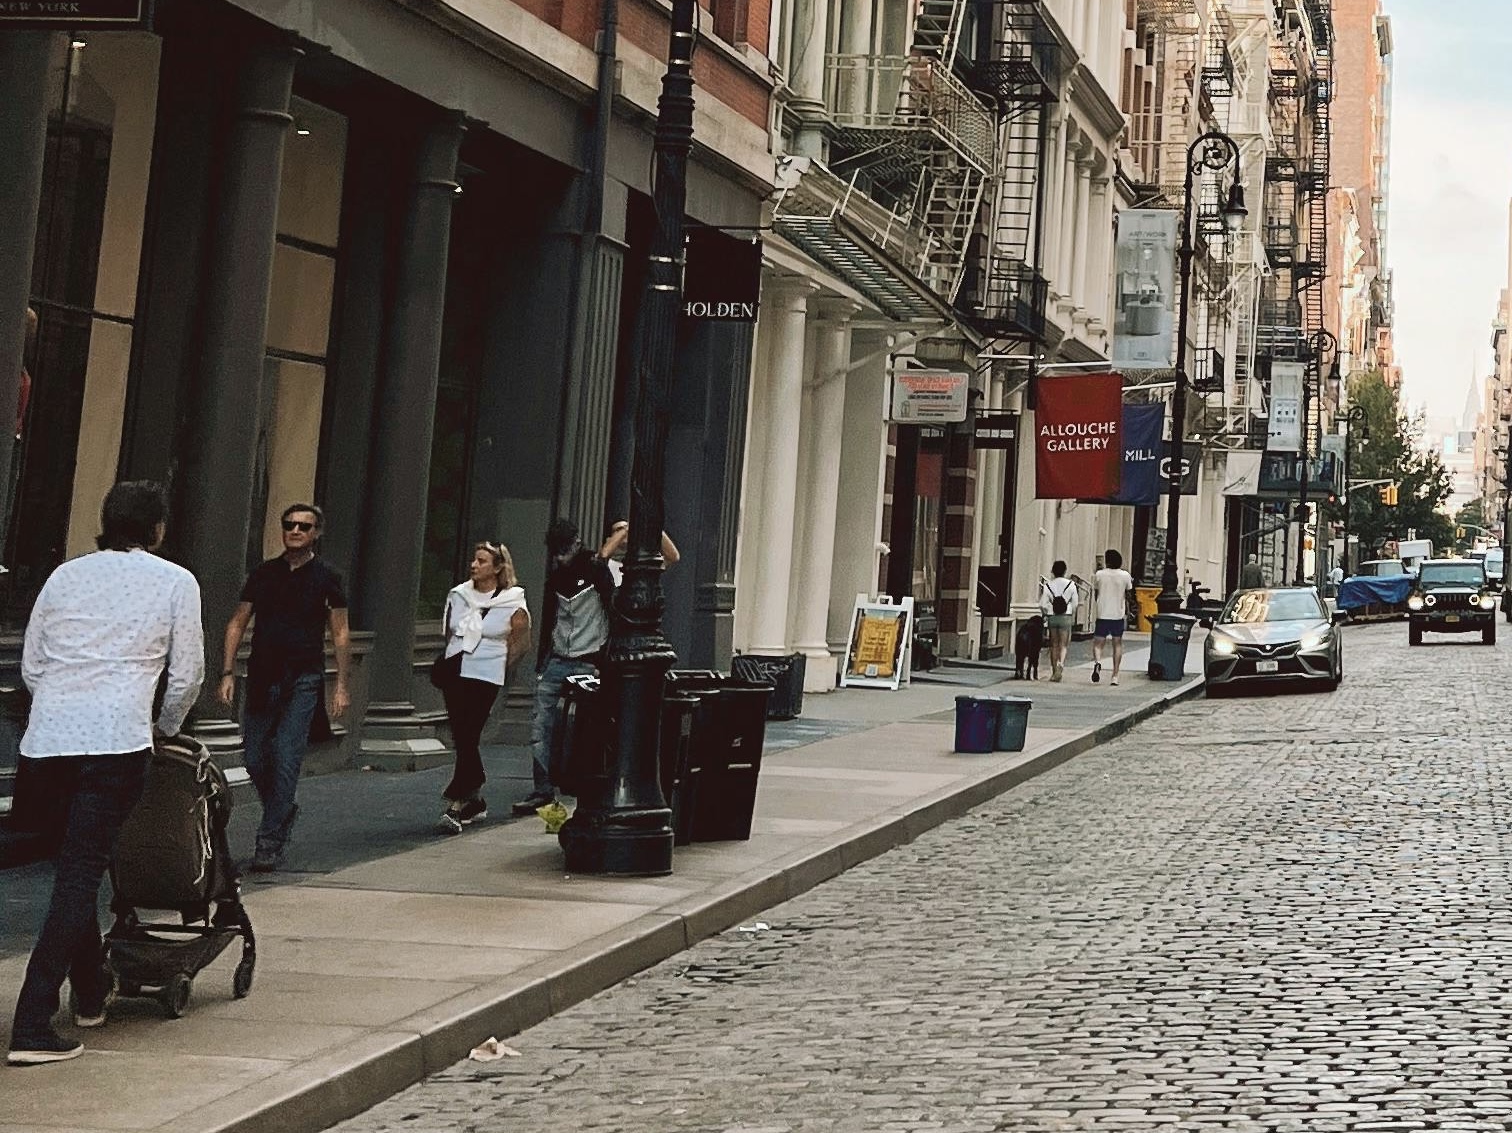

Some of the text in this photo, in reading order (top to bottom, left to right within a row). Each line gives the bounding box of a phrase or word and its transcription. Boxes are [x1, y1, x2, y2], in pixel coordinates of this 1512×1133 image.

[38, 2, 80, 12] YORK
[1040, 421, 1116, 437] ALLOUCHE
[1046, 437, 1110, 452] GALLERY
[1125, 448, 1156, 462] MILL
